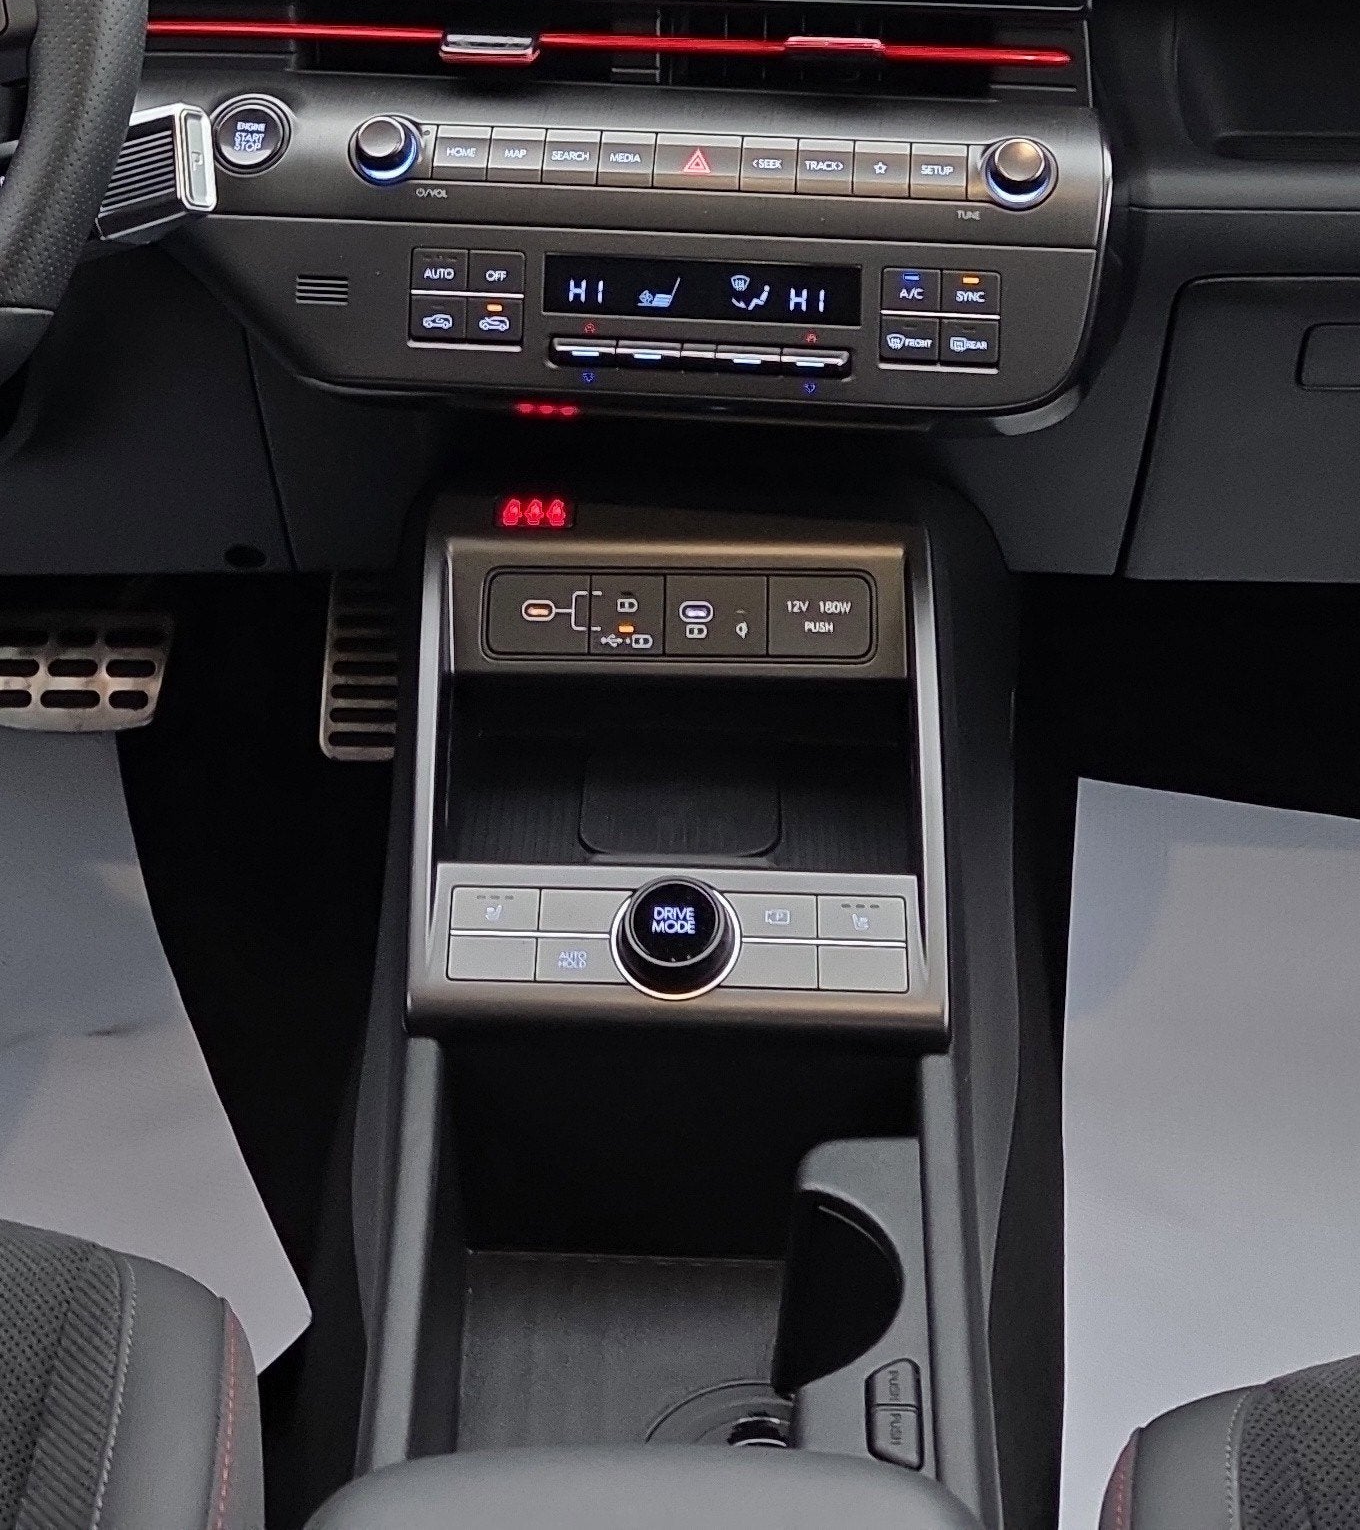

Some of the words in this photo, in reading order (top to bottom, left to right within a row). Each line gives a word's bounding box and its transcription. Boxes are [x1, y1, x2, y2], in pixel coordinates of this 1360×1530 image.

[234, 132, 265, 143] START
[233, 142, 262, 152] STOP
[445, 146, 477, 158] HOME
[504, 148, 527, 159] MAP
[551, 149, 590, 161] SEARCH
[609, 152, 641, 164] MEDIA
[920, 163, 954, 177] SETUP
[956, 209, 981, 221] TUNE
[423, 267, 455, 280] AUTO
[485, 270, 507, 282] OFF
[568, 278, 604, 304] HI
[899, 287, 924, 301] A/C
[789, 287, 825, 313] HI
[955, 291, 986, 304] SYNC
[903, 338, 933, 349] FRONT
[965, 339, 988, 351] REAR
[786, 599, 810, 613] 12V
[819, 600, 852, 614] 180W
[804, 620, 834, 633] PUSH
[653, 905, 696, 921] DRIVE
[651, 919, 696, 935] MODE
[558, 950, 588, 960] AUTO
[558, 960, 588, 970] HOLD
